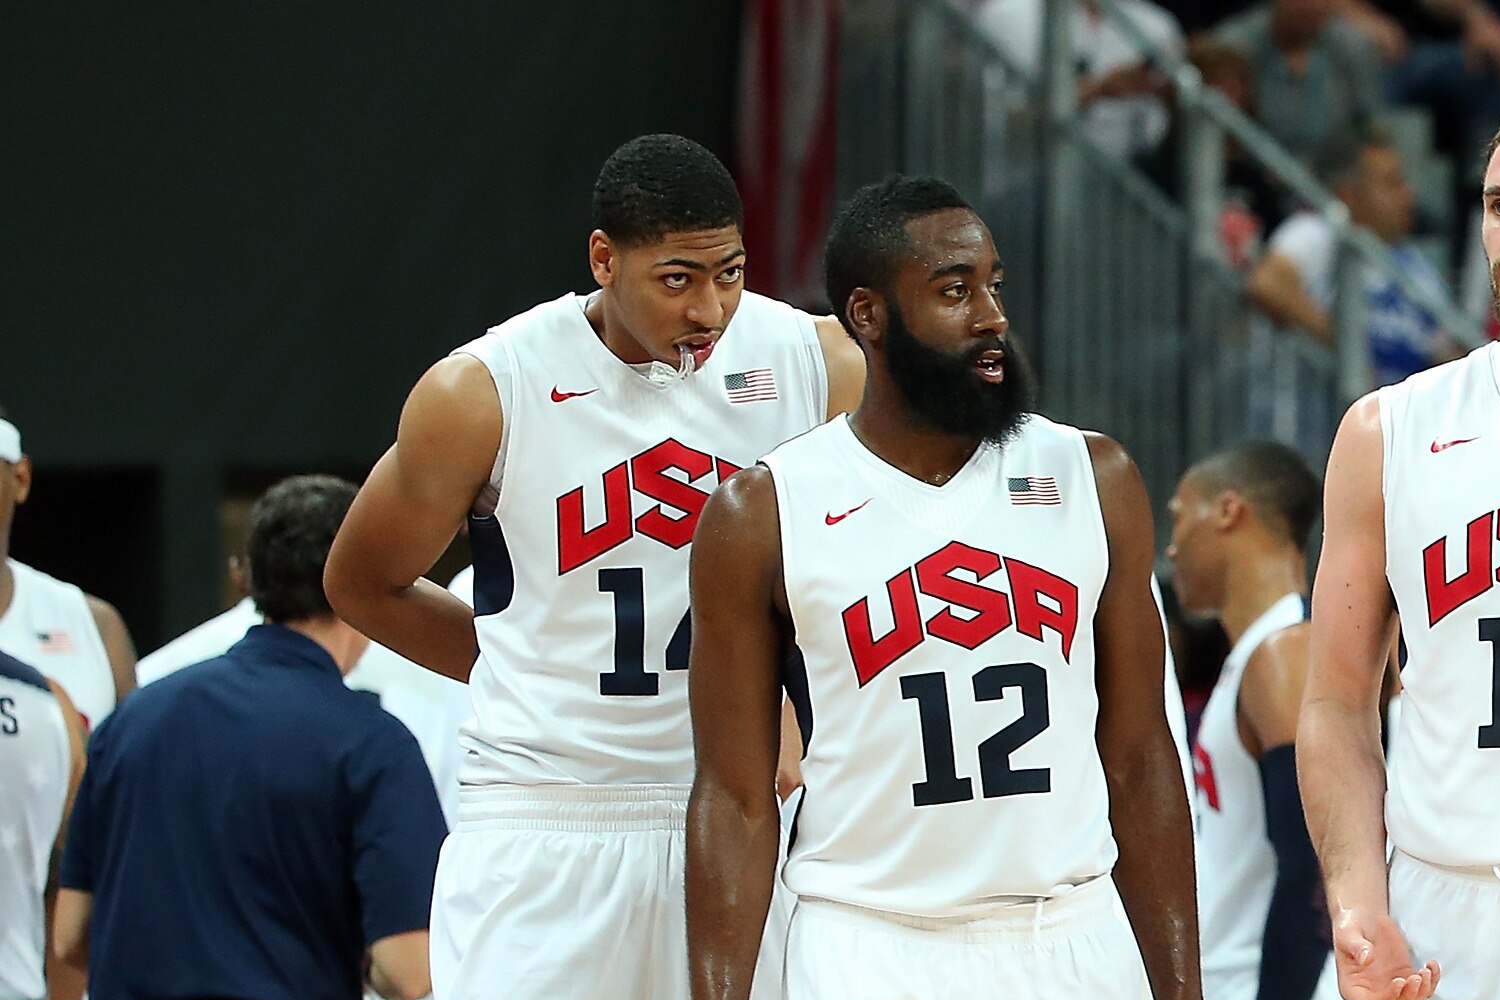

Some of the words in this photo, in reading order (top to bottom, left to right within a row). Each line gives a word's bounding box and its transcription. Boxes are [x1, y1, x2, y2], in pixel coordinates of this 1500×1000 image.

[556, 437, 740, 576] US
[841, 539, 1079, 688] USA
[900, 661, 1052, 808] 12
